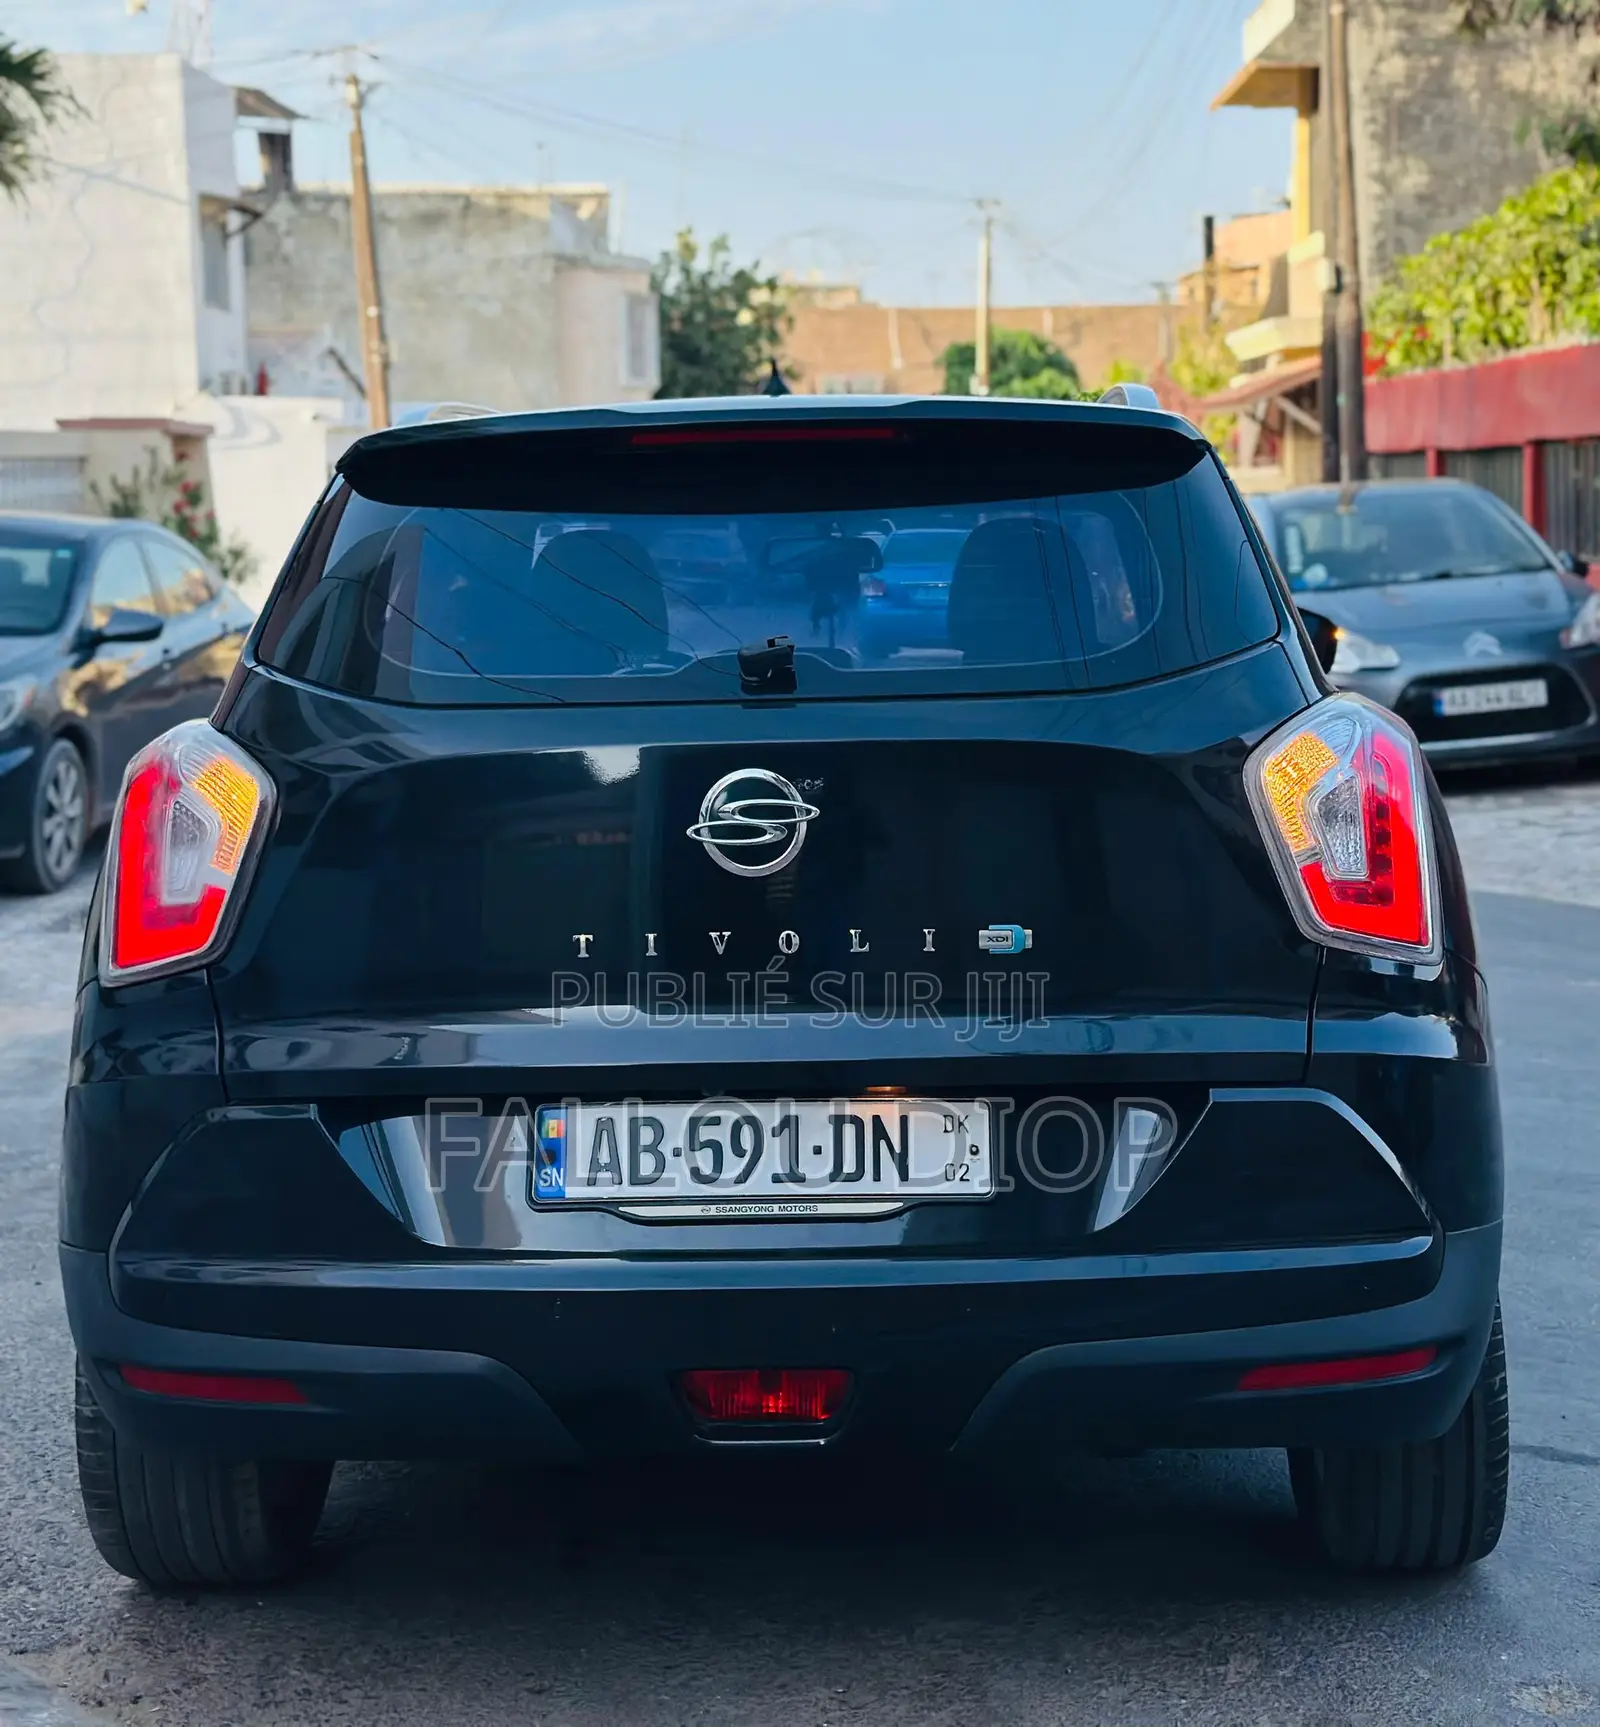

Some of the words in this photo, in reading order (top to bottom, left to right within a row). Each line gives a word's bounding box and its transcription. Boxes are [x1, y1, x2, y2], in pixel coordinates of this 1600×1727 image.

[572, 929, 936, 958] TIVOLI
[986, 935, 1009, 943] XDI
[942, 1114, 969, 1134] DK
[539, 1168, 564, 1187] SN
[715, 1205, 775, 1214] SSANGYONG
[778, 1204, 819, 1213] MOTORS
